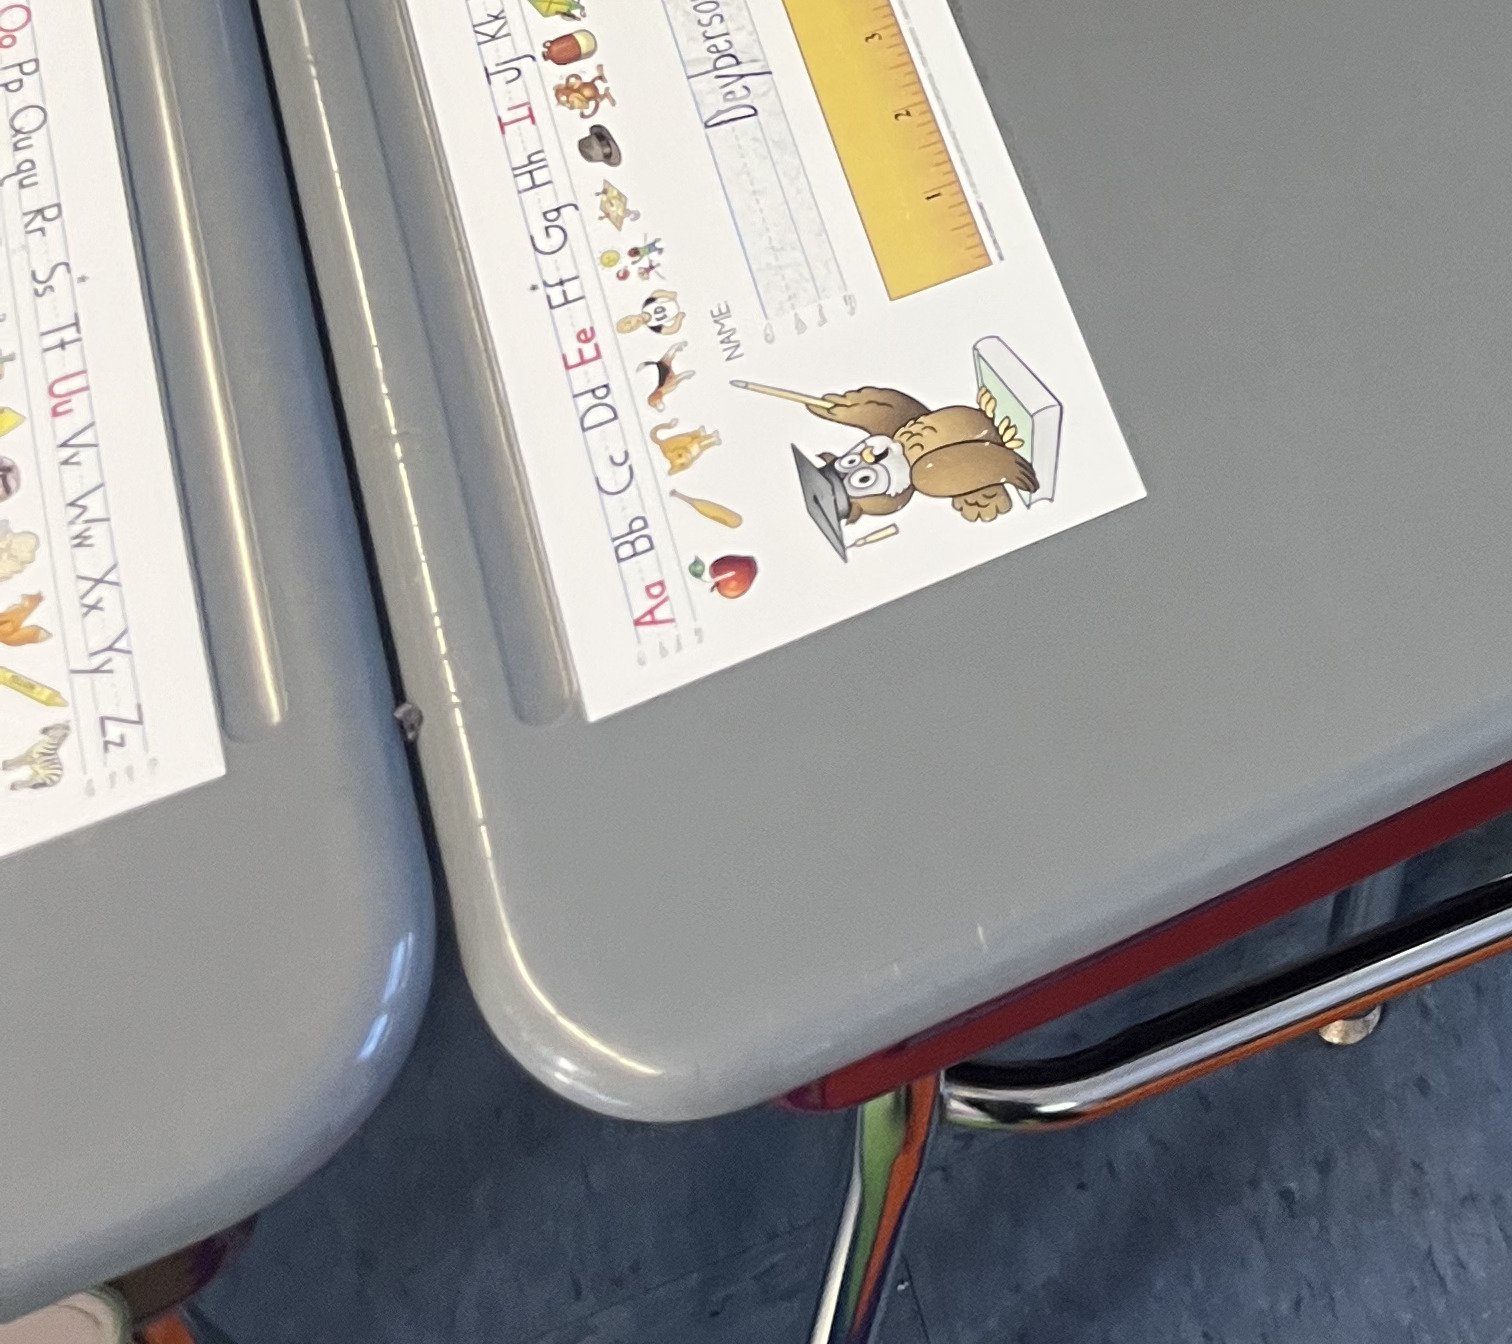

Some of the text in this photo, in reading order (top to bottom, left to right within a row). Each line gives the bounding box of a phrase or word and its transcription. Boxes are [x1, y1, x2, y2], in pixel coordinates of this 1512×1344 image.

[473, 10, 512, 46] Kk
[864, 32, 883, 43] 3
[0, 58, 40, 93] Pp
[484, 53, 536, 85] Jj
[498, 102, 536, 136] Ii
[894, 109, 912, 122] 2
[512, 149, 553, 194] Hh
[22, 202, 62, 238] Rr
[530, 203, 579, 256] Gg
[31, 261, 71, 299] Ss
[543, 275, 586, 310] Ff
[40, 312, 83, 354] Tt
[562, 326, 603, 371] Ee
[710, 300, 744, 362] NAME
[48, 369, 90, 418] Uu
[573, 383, 619, 432] Dd
[57, 420, 99, 466] Vv
[595, 450, 635, 497] Cc
[65, 483, 111, 548] Ww
[611, 515, 655, 564] Bb
[76, 563, 122, 618] Xx
[634, 579, 676, 627] Aa
[69, 626, 132, 674] Yy
[99, 703, 144, 754] Zz
